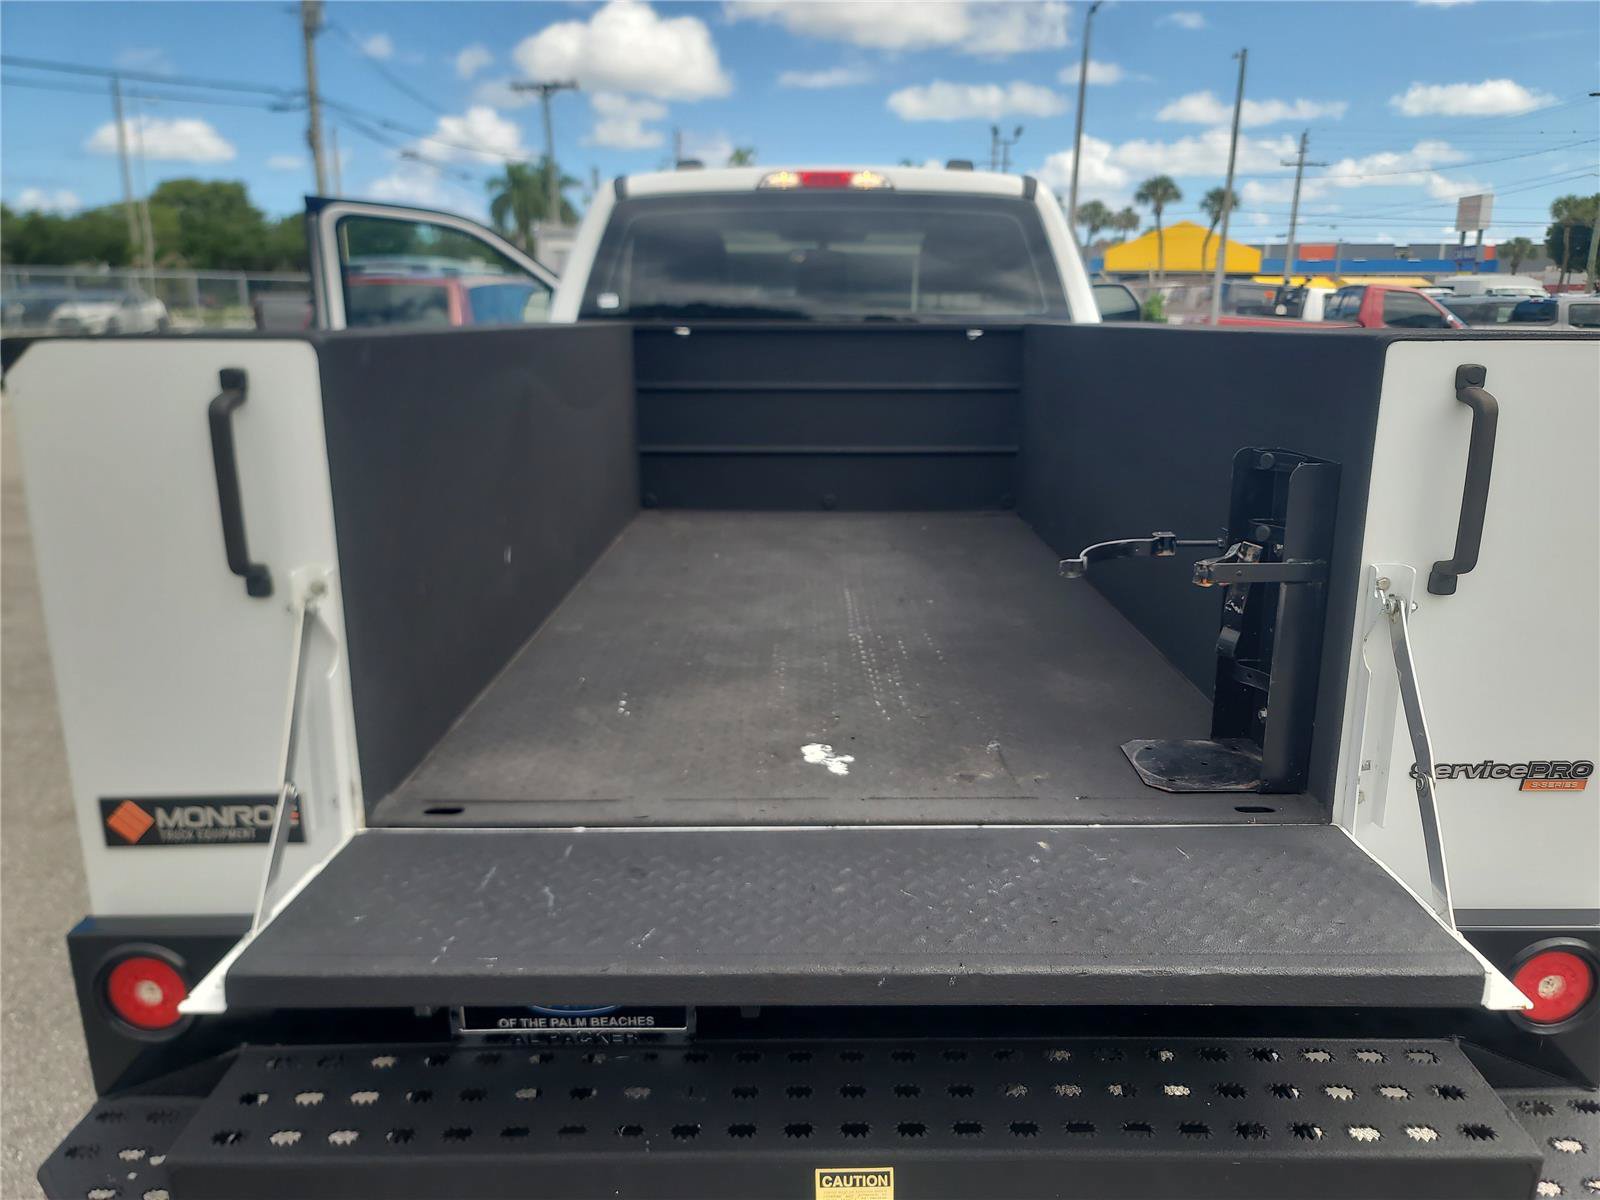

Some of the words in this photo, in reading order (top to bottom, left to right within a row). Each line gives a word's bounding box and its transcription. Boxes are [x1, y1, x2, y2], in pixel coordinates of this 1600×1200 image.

[160, 828, 194, 841] TRUCK
[197, 827, 256, 840] EQUIPMENT
[499, 1018, 516, 1029] OF
[520, 1018, 547, 1028] THE
[551, 1017, 587, 1028] PALM
[591, 1016, 655, 1027] BEACHES
[821, 1174, 889, 1188] CAUTION
